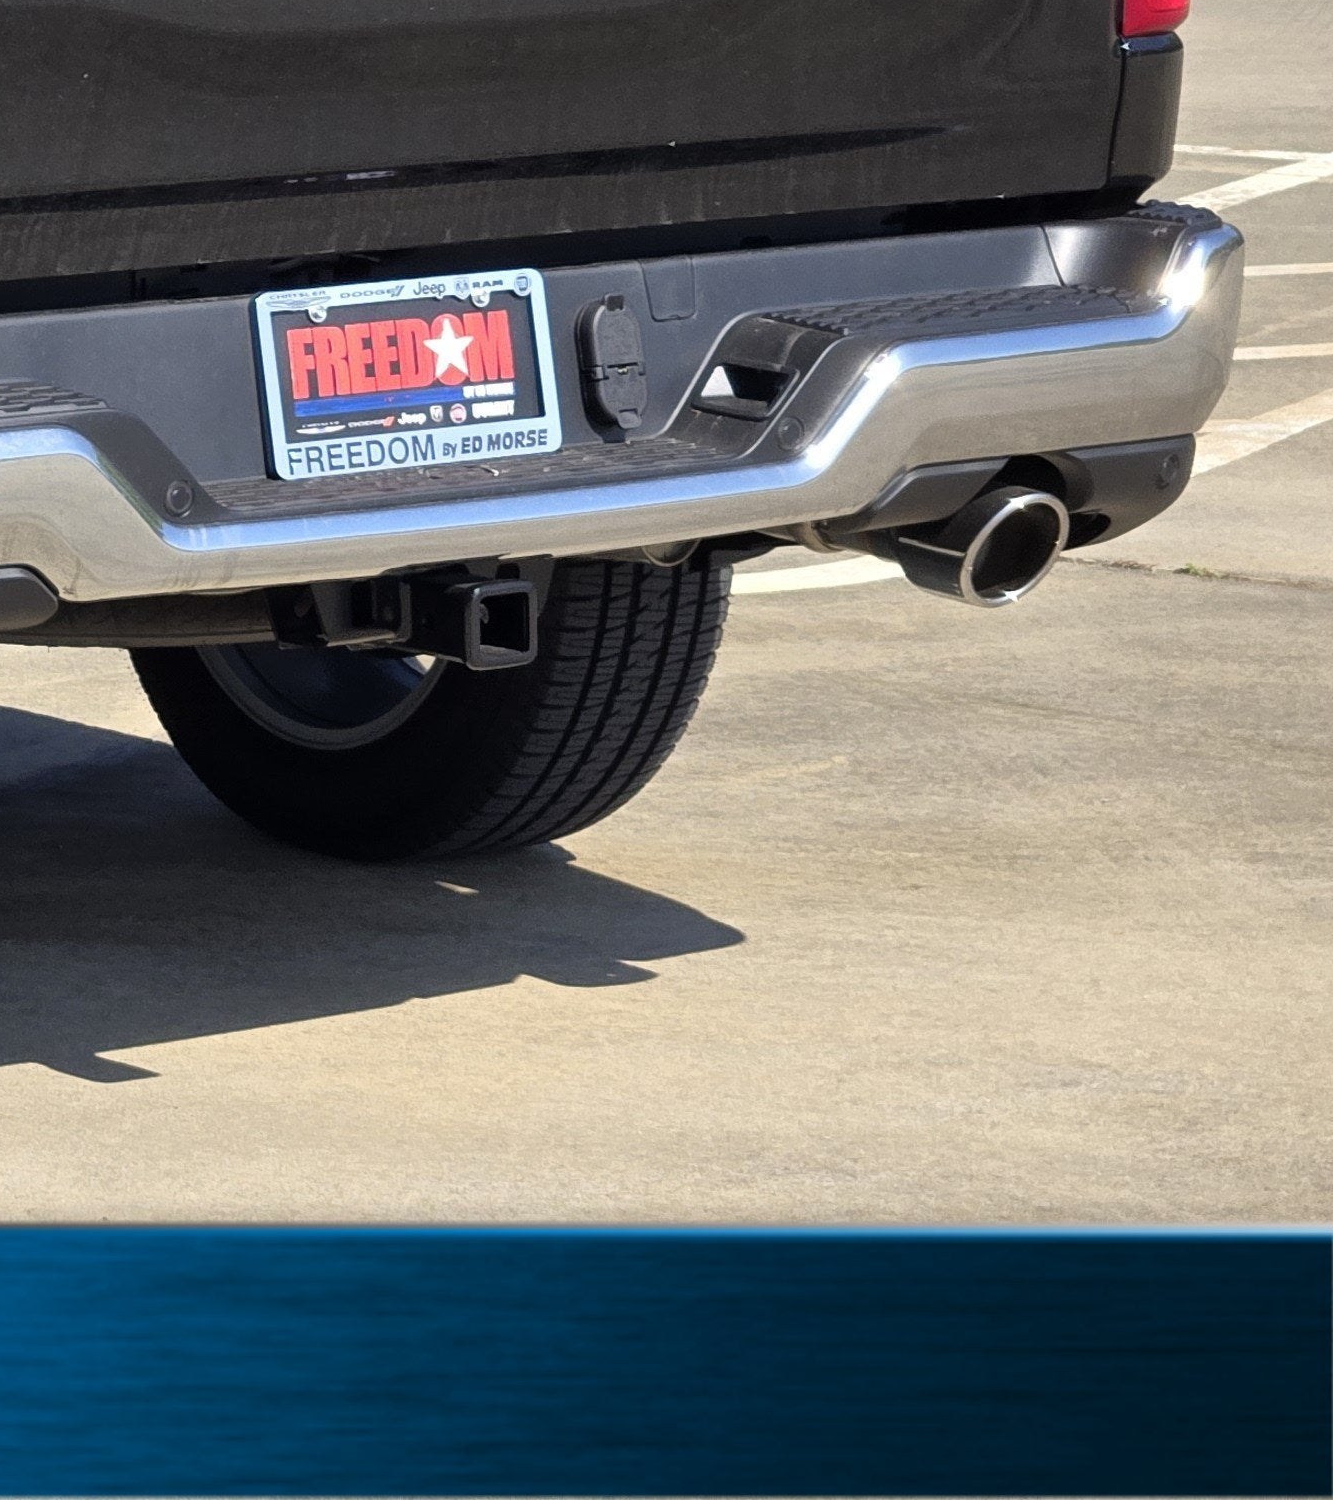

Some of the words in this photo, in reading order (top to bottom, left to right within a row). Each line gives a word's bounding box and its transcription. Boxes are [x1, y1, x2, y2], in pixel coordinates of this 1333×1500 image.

[413, 281, 446, 297] Jeep
[472, 280, 504, 288] RAM
[287, 311, 515, 398] FREEDOM
[287, 433, 437, 476] FREEDOM
[460, 435, 483, 455] ED
[486, 428, 548, 451] MORSE
